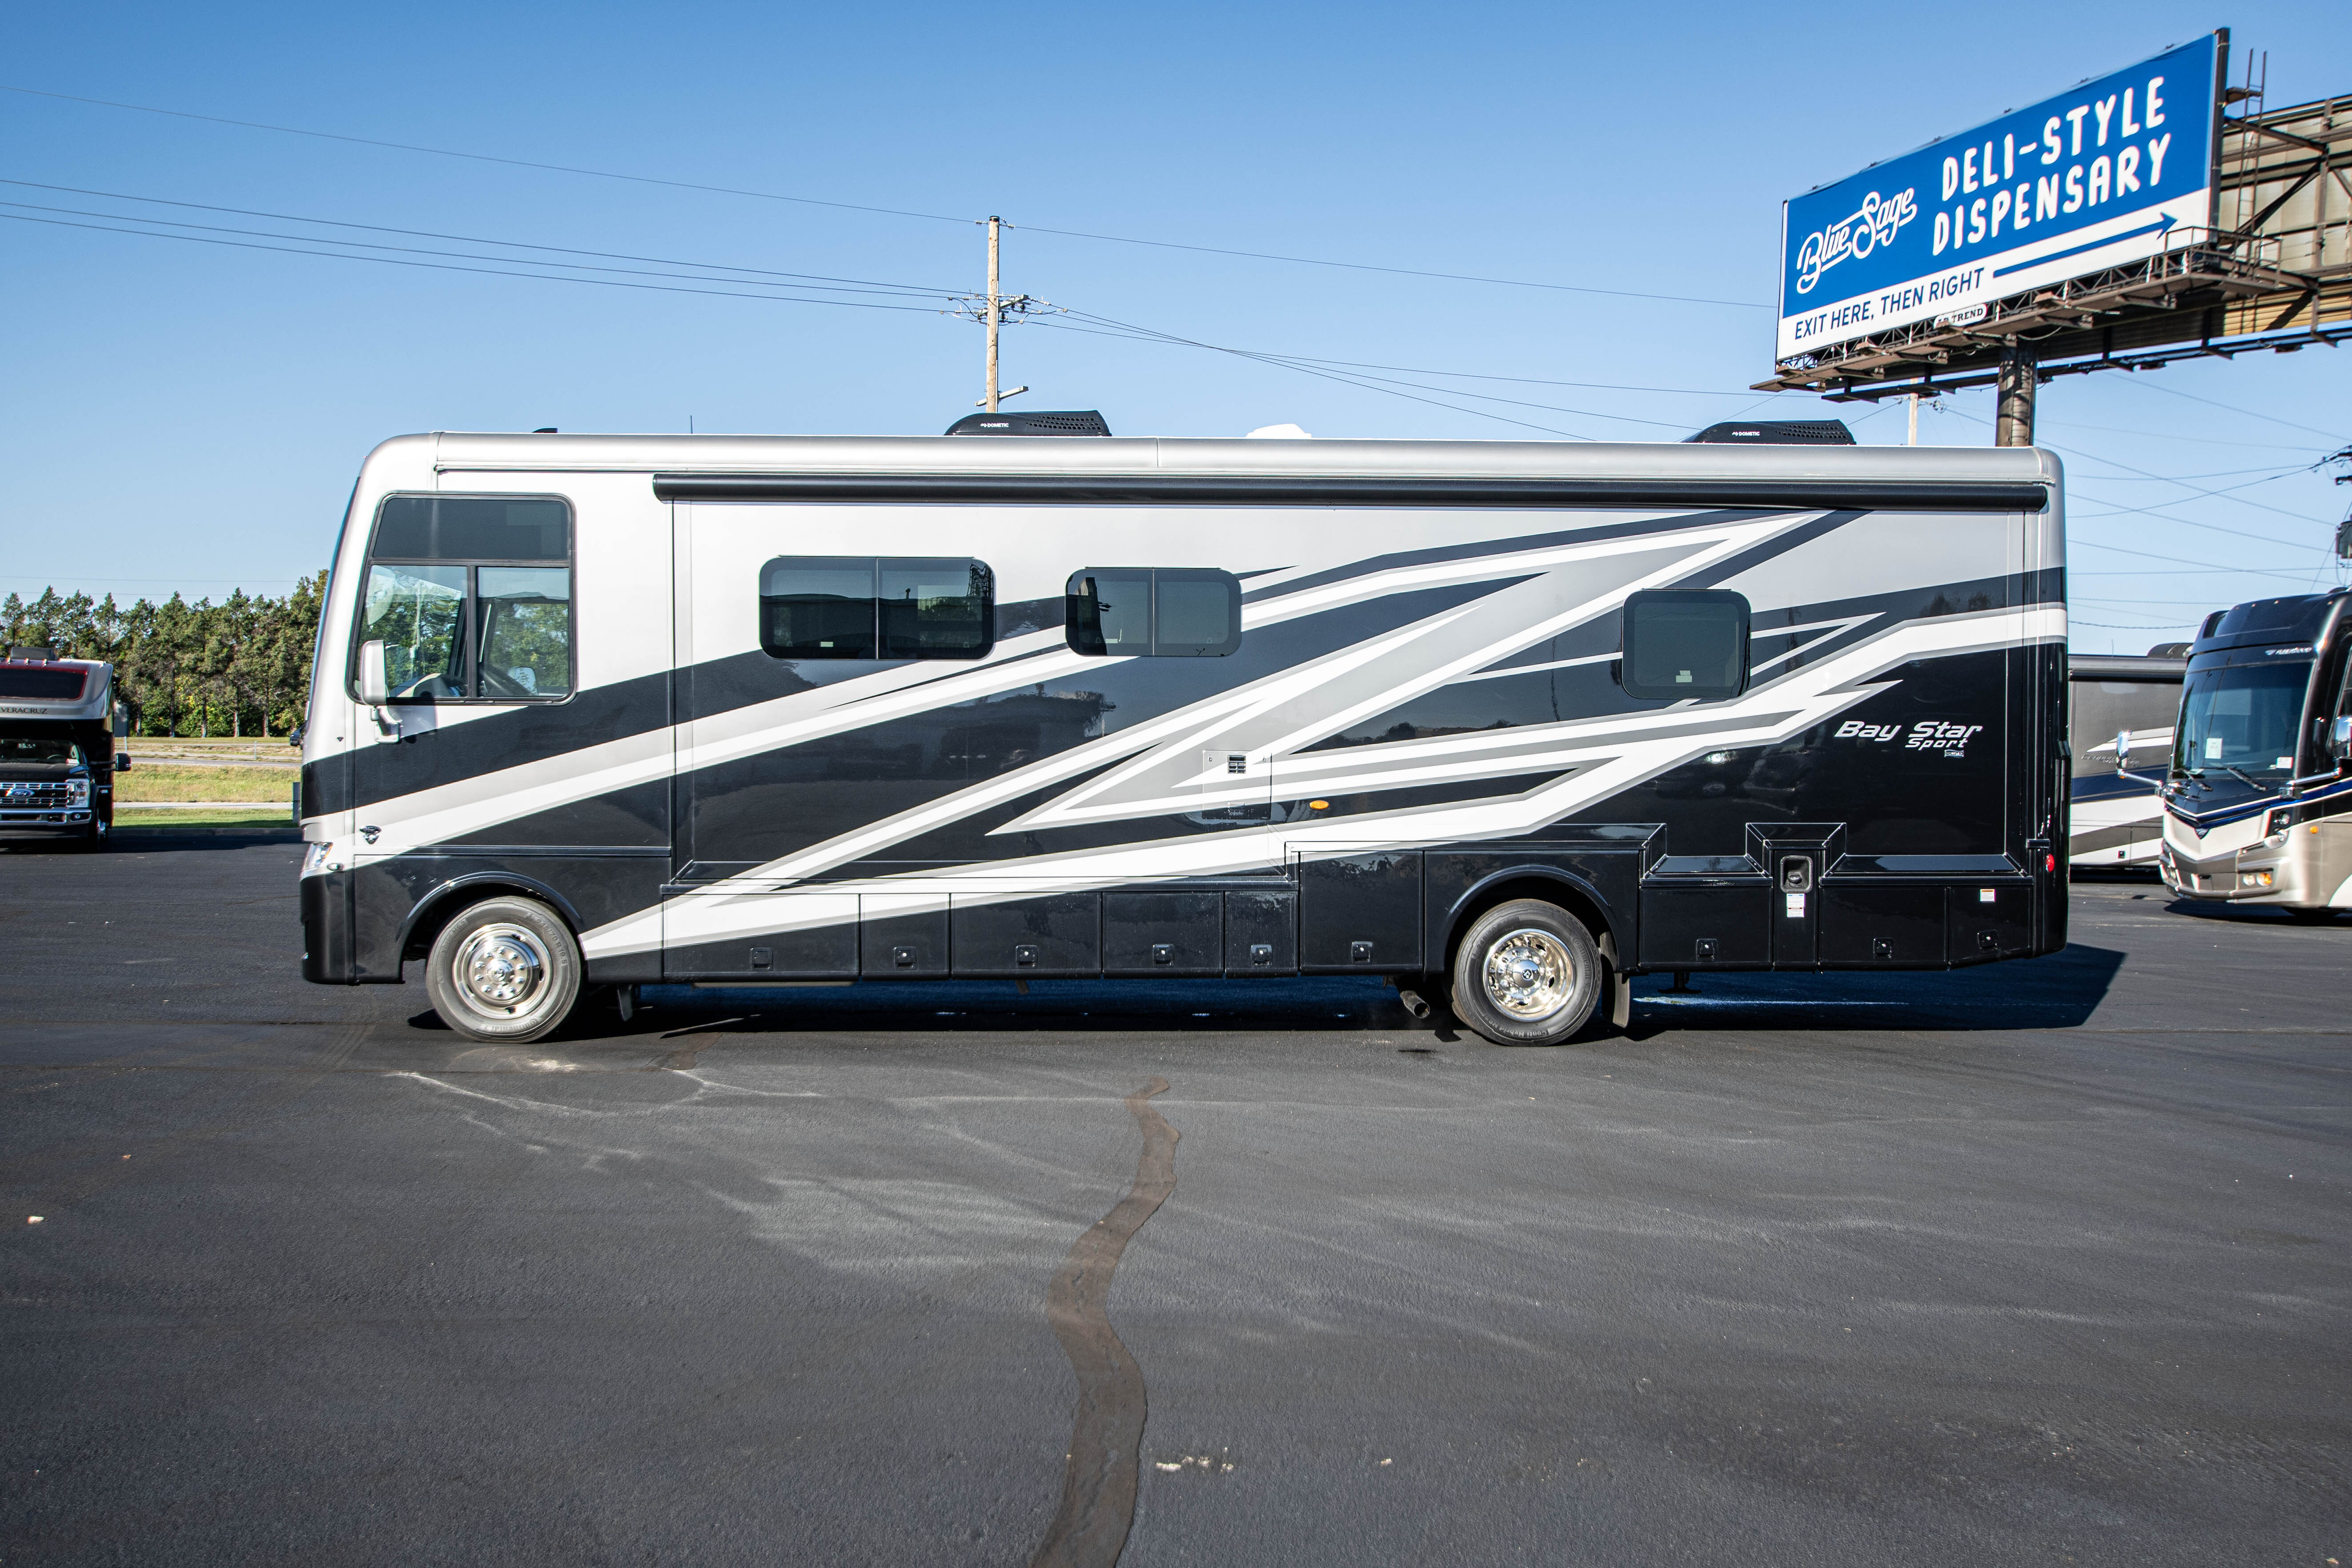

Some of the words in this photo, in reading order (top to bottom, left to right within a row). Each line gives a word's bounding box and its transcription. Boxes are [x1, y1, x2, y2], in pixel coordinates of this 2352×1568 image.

[1942, 76, 2165, 201] DELI-STYLE
[1932, 132, 2171, 256] DISPENSARY
[1796, 224, 1852, 294] Blue
[1831, 187, 1918, 259] Sage
[1795, 313, 1827, 340] EXIT
[1830, 301, 1874, 329] HERE,
[1881, 285, 1924, 315] THEN
[1929, 267, 1984, 302] RIGHT
[1951, 308, 1983, 323] TREND
[1834, 721, 1902, 742] Bay
[1908, 722, 1983, 738] Star
[1905, 738, 1968, 750] Sport
[1572, 936, 1591, 979] Continental
[1499, 1025, 1525, 1037] Hybrid
[1526, 1029, 1547, 1038] Conti
